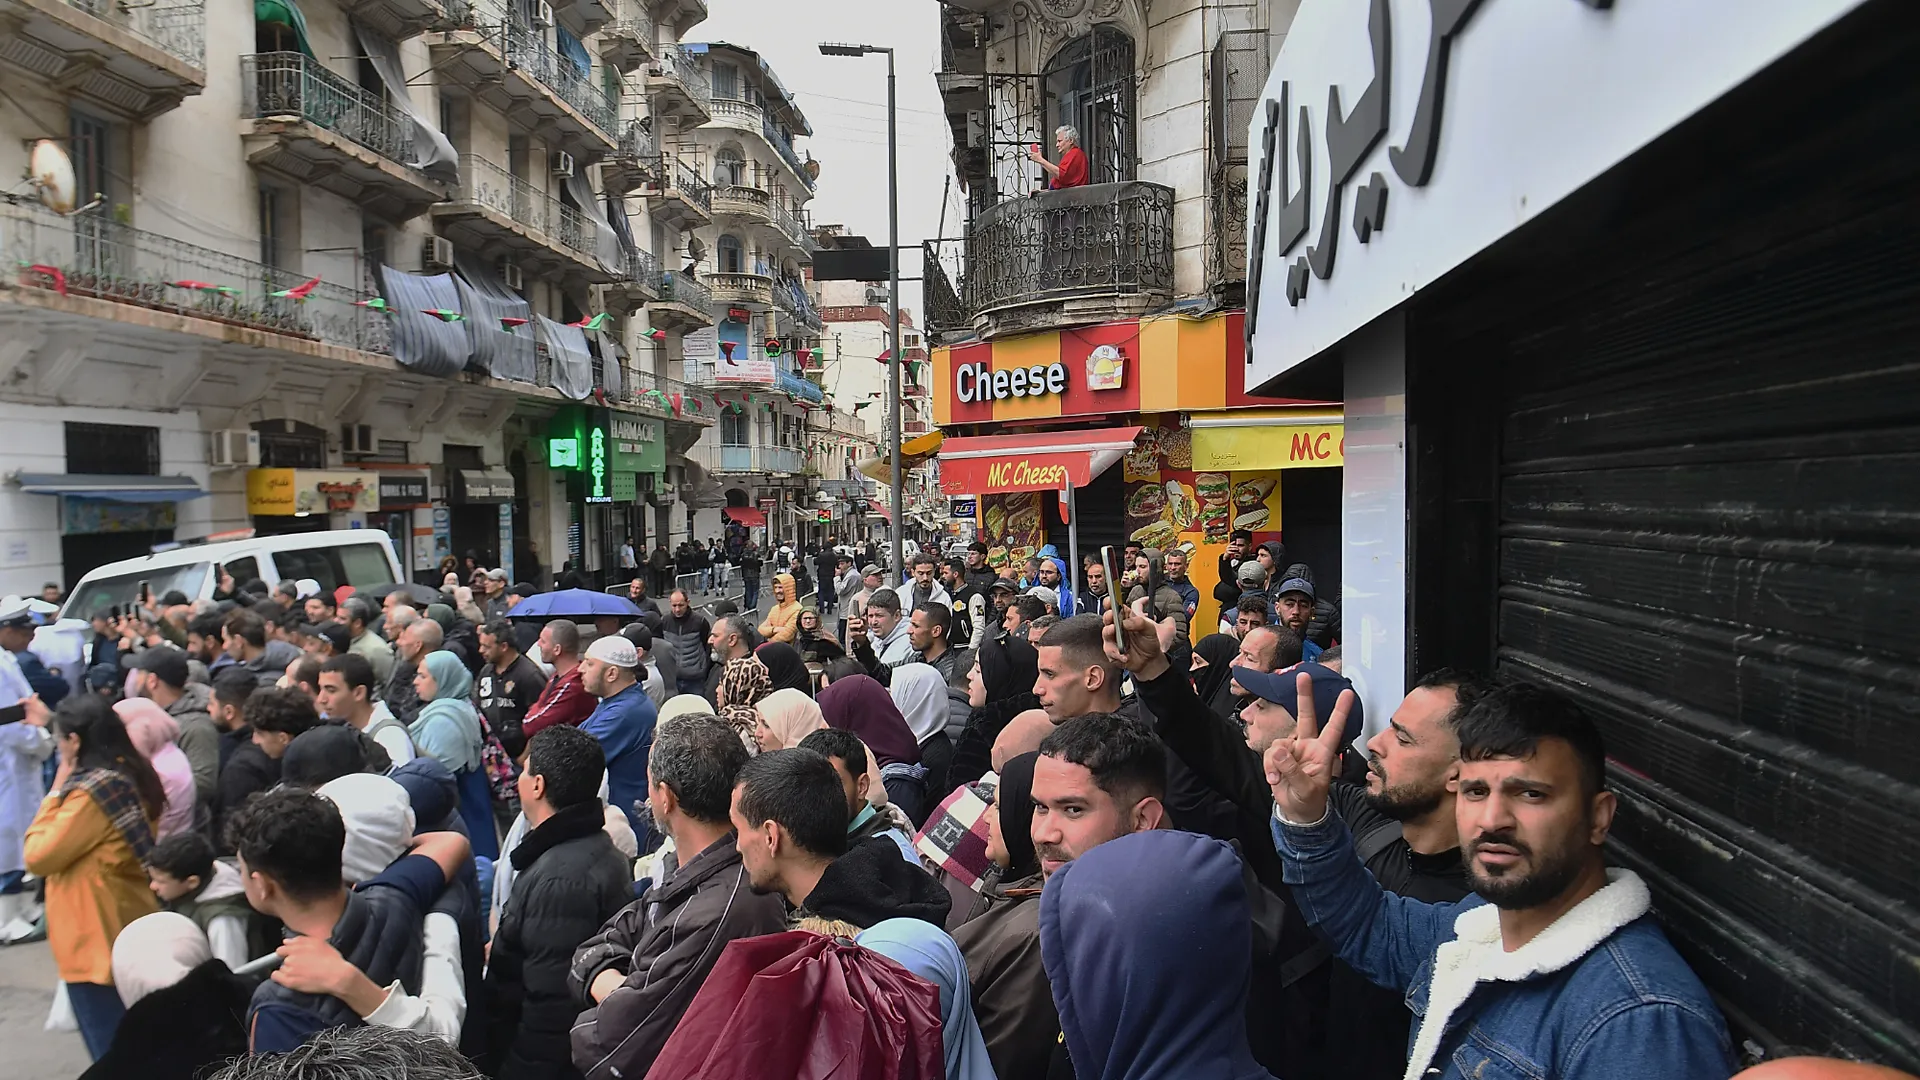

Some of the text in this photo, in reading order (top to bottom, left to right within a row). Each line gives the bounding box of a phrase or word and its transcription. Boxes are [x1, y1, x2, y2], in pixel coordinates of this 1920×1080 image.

[956, 360, 1068, 403] Cheese
[611, 419, 656, 442] HARMACIE
[1290, 432, 1331, 461] MC
[987, 462, 1012, 488] MC
[1013, 459, 1065, 486] Cheese
[954, 504, 976, 515] FLEX
[479, 676, 492, 697] 3
